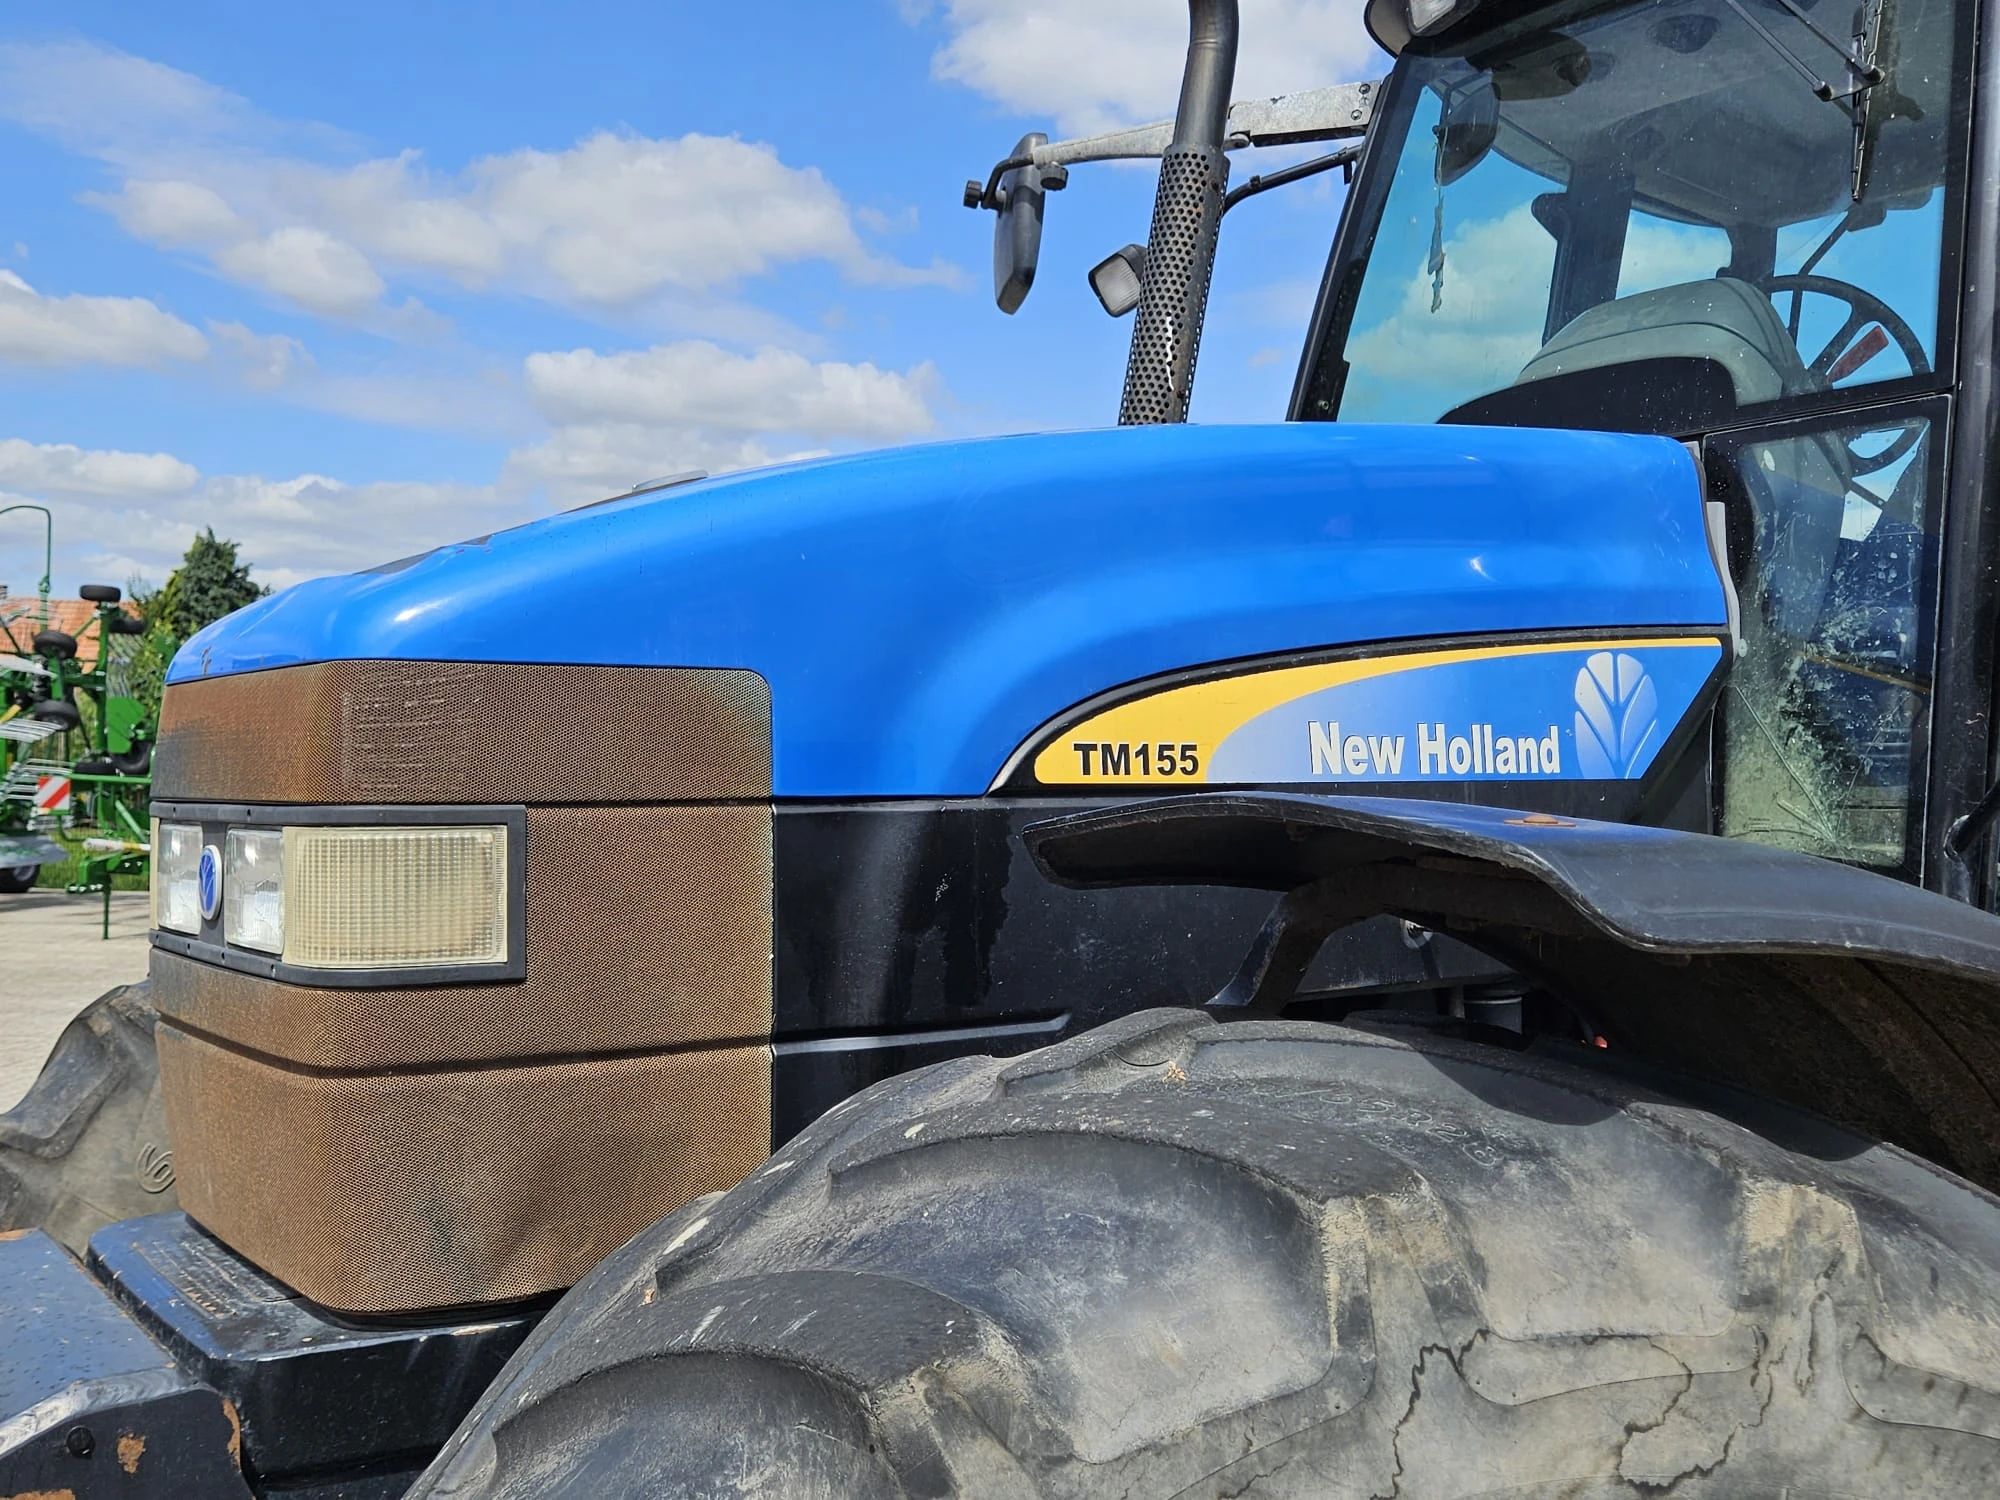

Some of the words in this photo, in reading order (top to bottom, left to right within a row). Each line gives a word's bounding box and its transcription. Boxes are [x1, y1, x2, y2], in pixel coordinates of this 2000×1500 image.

[1073, 743, 1199, 776] TM155
[1308, 720, 1405, 775] New
[1417, 722, 1560, 775] Holland
